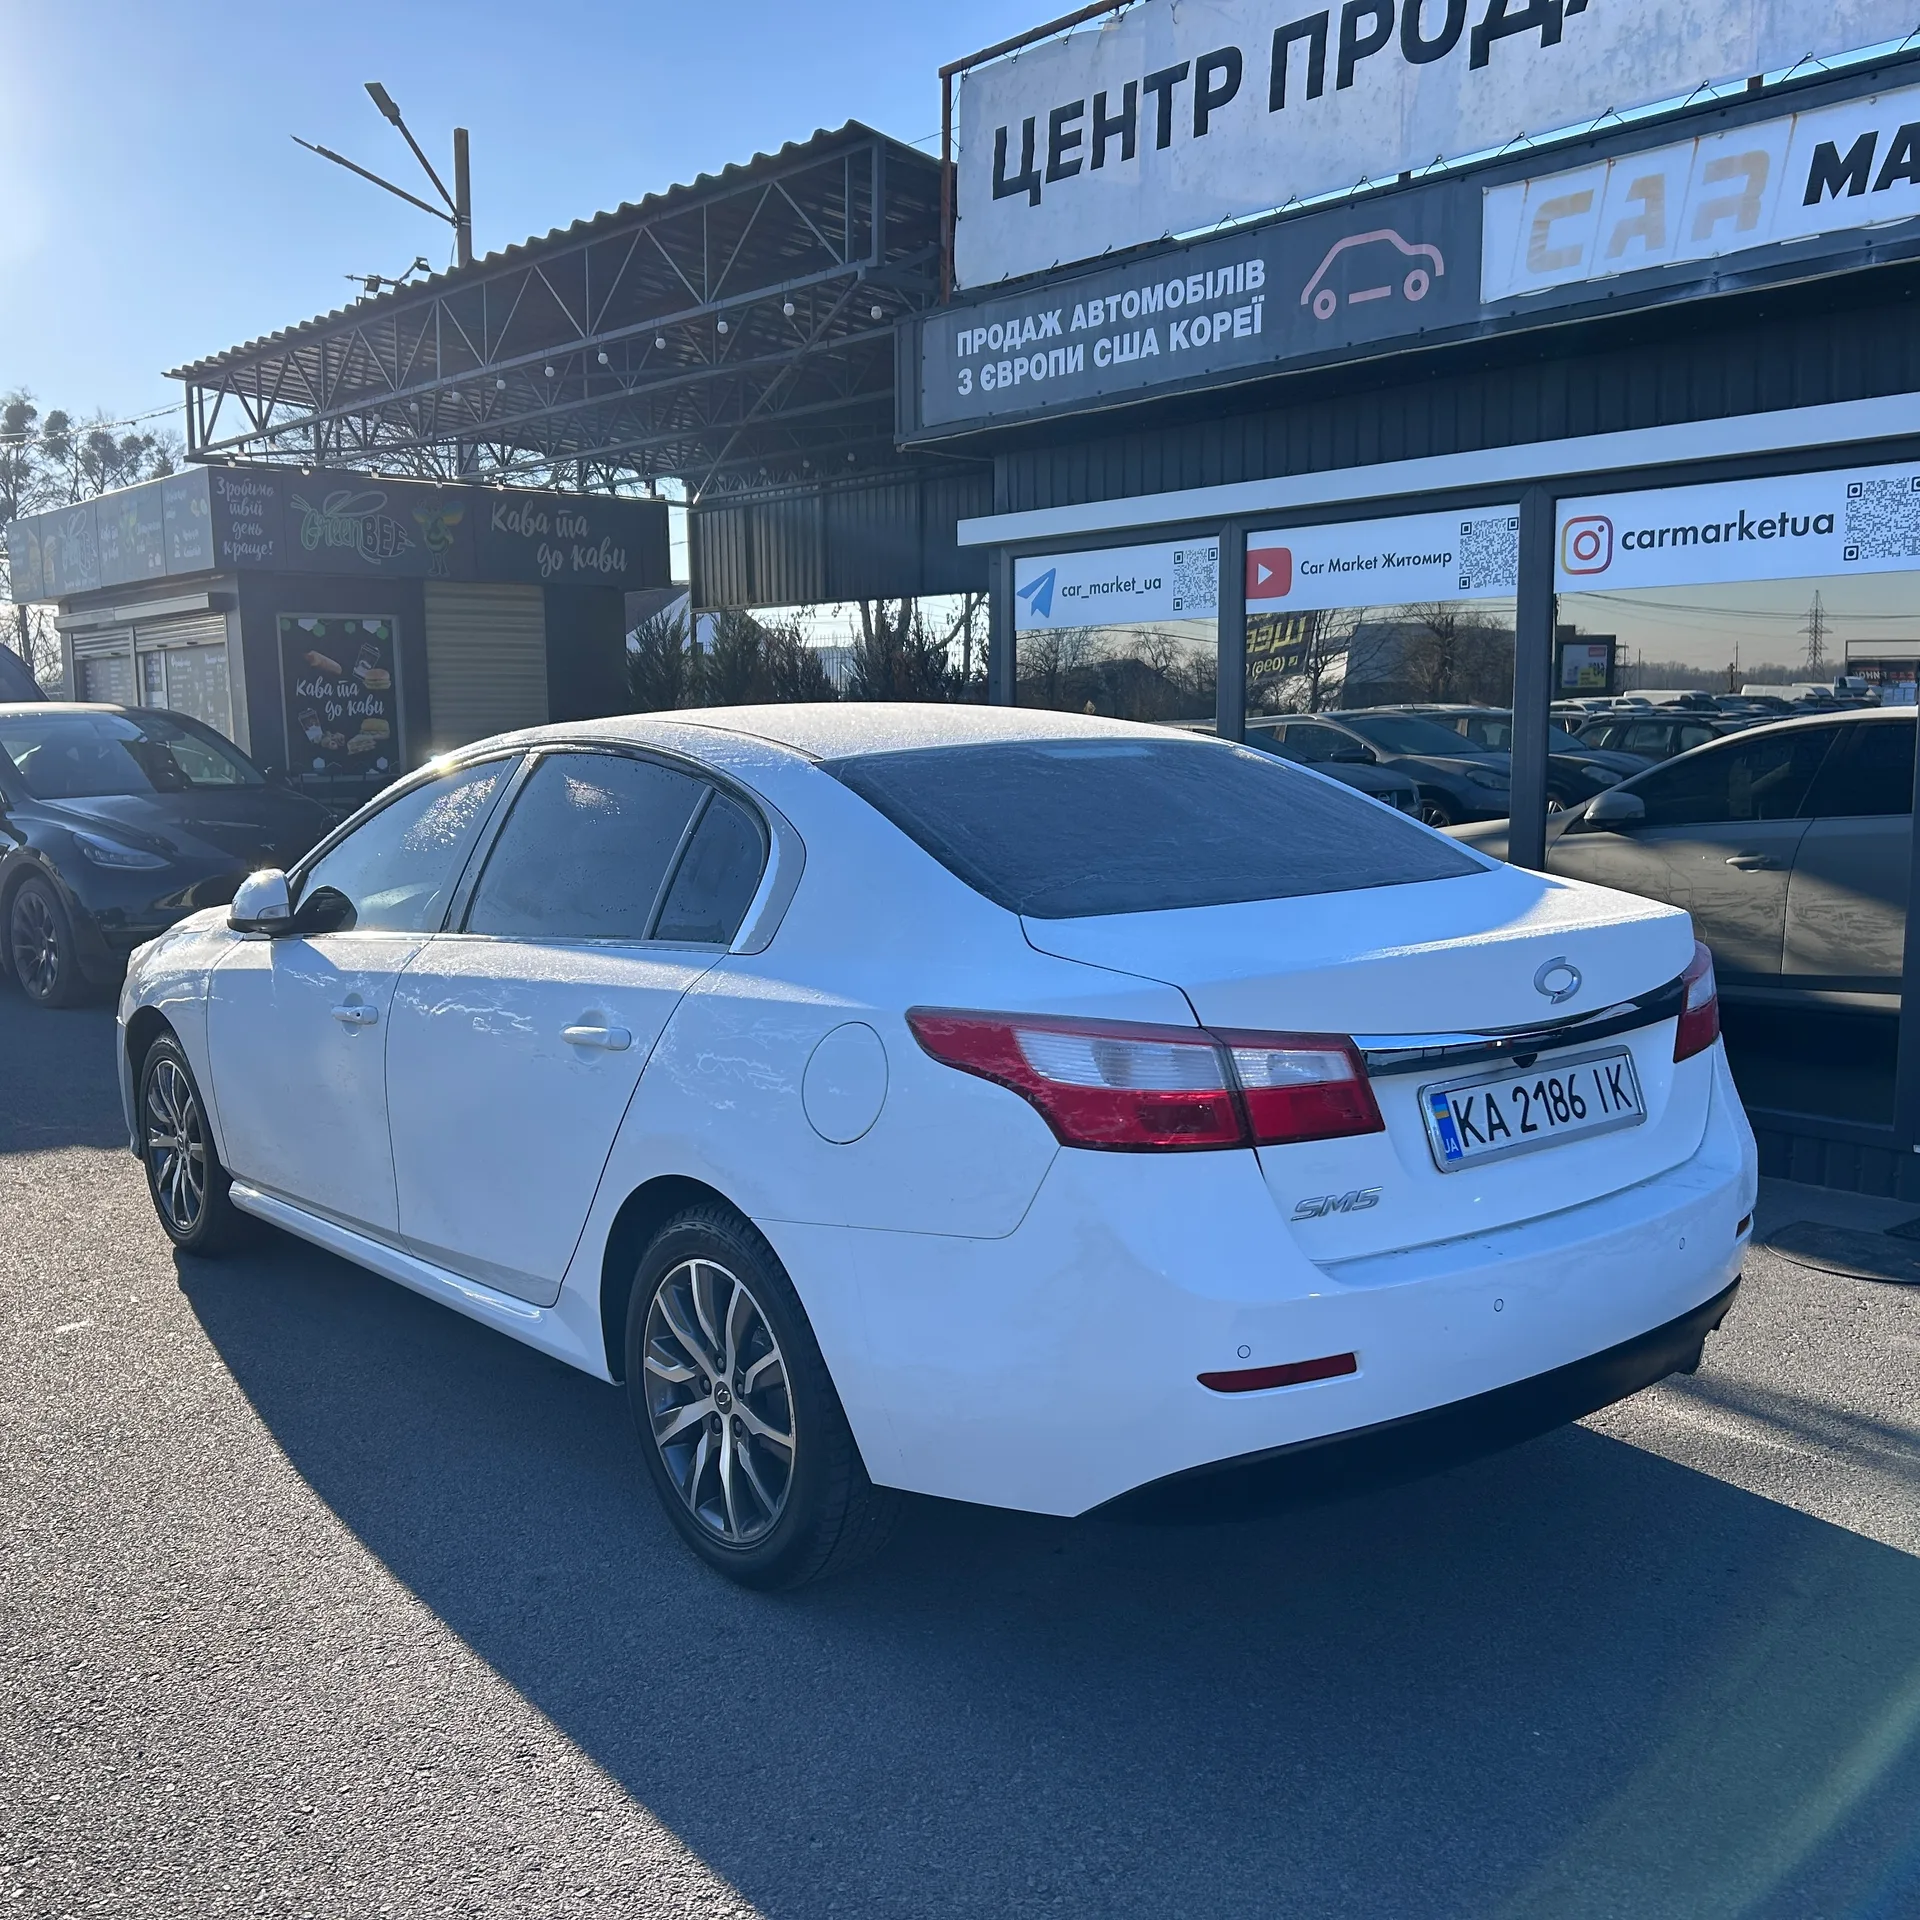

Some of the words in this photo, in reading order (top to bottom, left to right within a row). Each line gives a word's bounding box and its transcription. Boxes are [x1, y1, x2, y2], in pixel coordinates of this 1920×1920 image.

[993, 46, 1242, 207] ЦЕНТР
[1269, 0, 1588, 113] ПРОД
[1526, 150, 1770, 274] CAR
[957, 308, 1062, 357] ПРОДАЖ
[1070, 259, 1266, 332] АВТОМОБІЛІВ
[957, 368, 973, 395] З
[980, 344, 1084, 391] ЄВРОПИ
[1093, 328, 1160, 367] США
[1169, 295, 1266, 352] КОРЕЇ
[216, 476, 275, 502] Зробимо
[229, 498, 264, 518] твій
[491, 500, 551, 538] Кава
[556, 509, 590, 539] та
[232, 520, 264, 541] день
[1621, 509, 1835, 551] carmarketua
[223, 540, 274, 563] краще!
[537, 542, 564, 578] до
[570, 536, 628, 573] кави
[1300, 560, 1325, 575] Car
[1328, 555, 1378, 573] Market
[1381, 552, 1453, 568] Житомир
[1061, 575, 1162, 599] car_market_ua
[296, 676, 334, 699] Кава
[337, 680, 360, 698] та
[325, 699, 343, 722] до
[347, 694, 385, 716] кави
[1452, 1096, 1511, 1148] KA
[1512, 1074, 1587, 1134] 2186
[1593, 1064, 1633, 1114] IK
[1290, 1186, 1384, 1222] SM5
